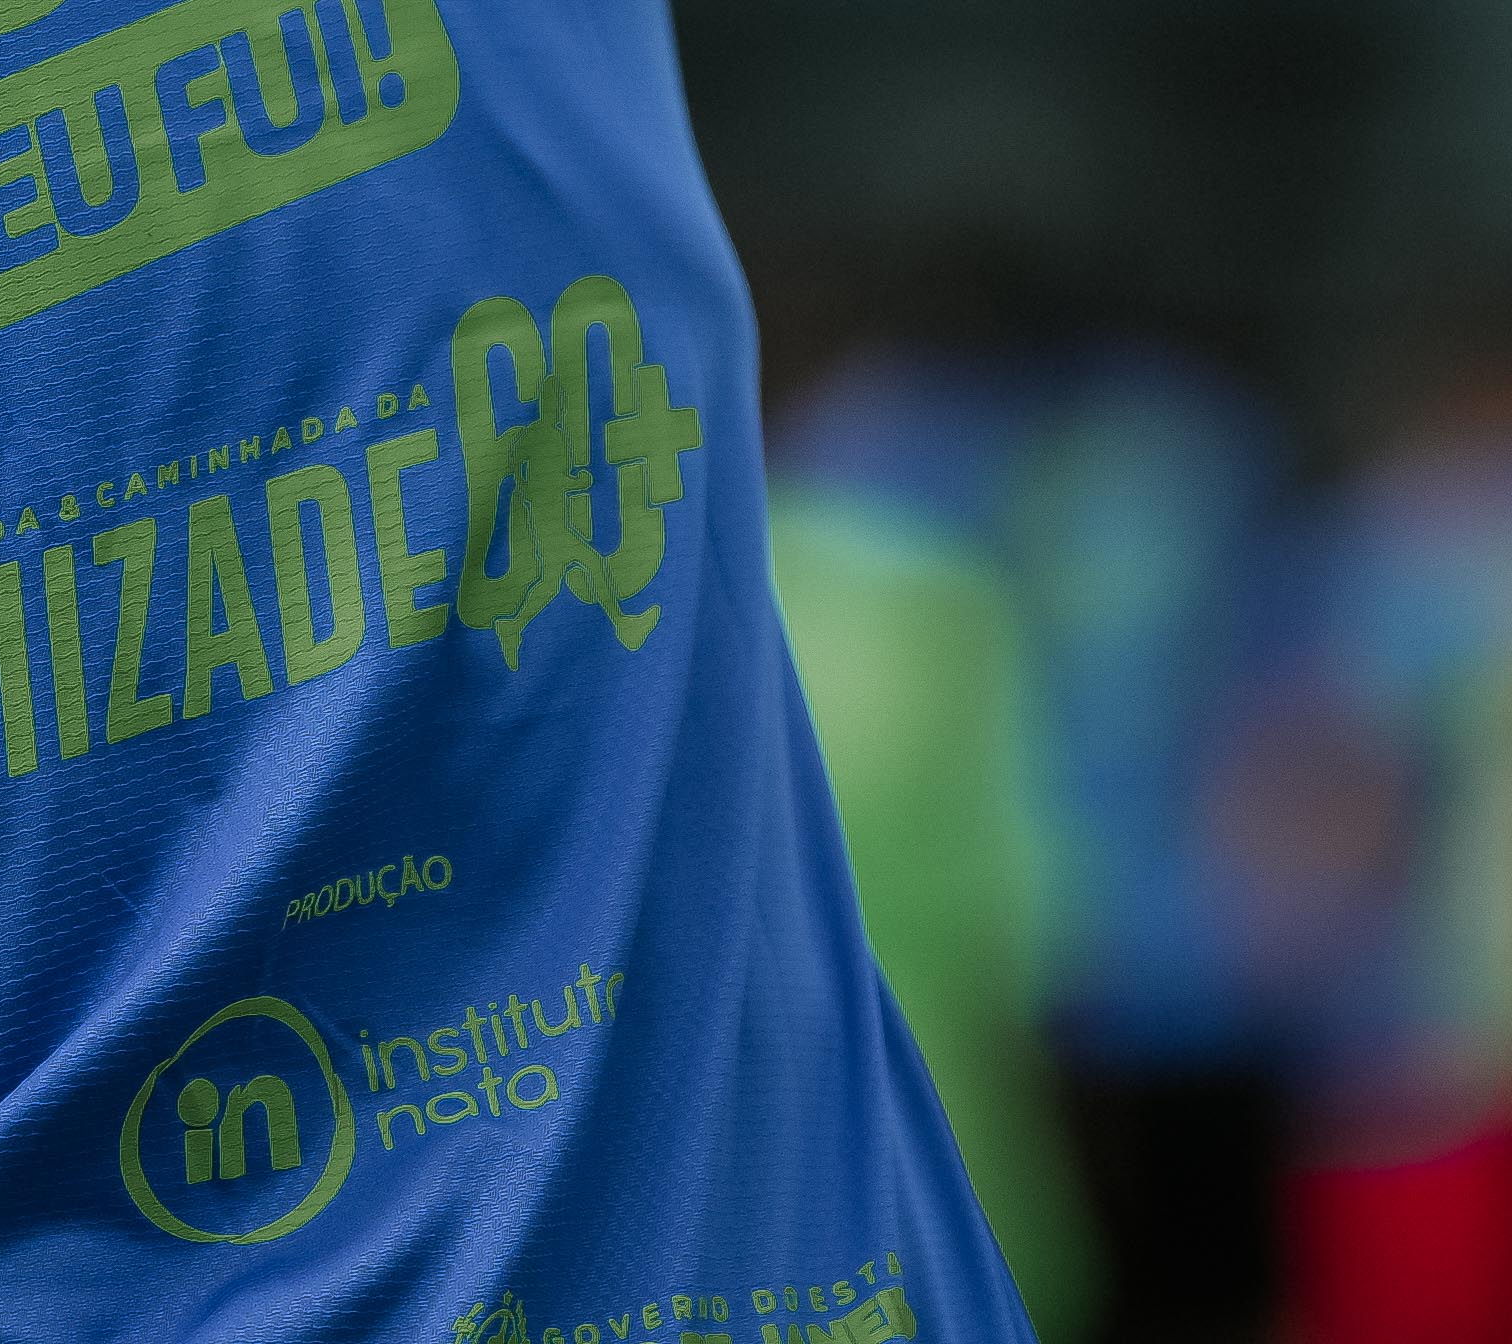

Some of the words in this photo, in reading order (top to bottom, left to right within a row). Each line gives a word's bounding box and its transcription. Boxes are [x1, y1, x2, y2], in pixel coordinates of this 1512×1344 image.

[58, 494, 80, 521] &
[94, 406, 359, 510] CAMINHADA
[376, 383, 432, 421] DA
[451, 274, 704, 630] 60+
[282, 854, 453, 931] PRODUÇÃO
[177, 1071, 301, 1186] in
[377, 1064, 560, 1151] nata
